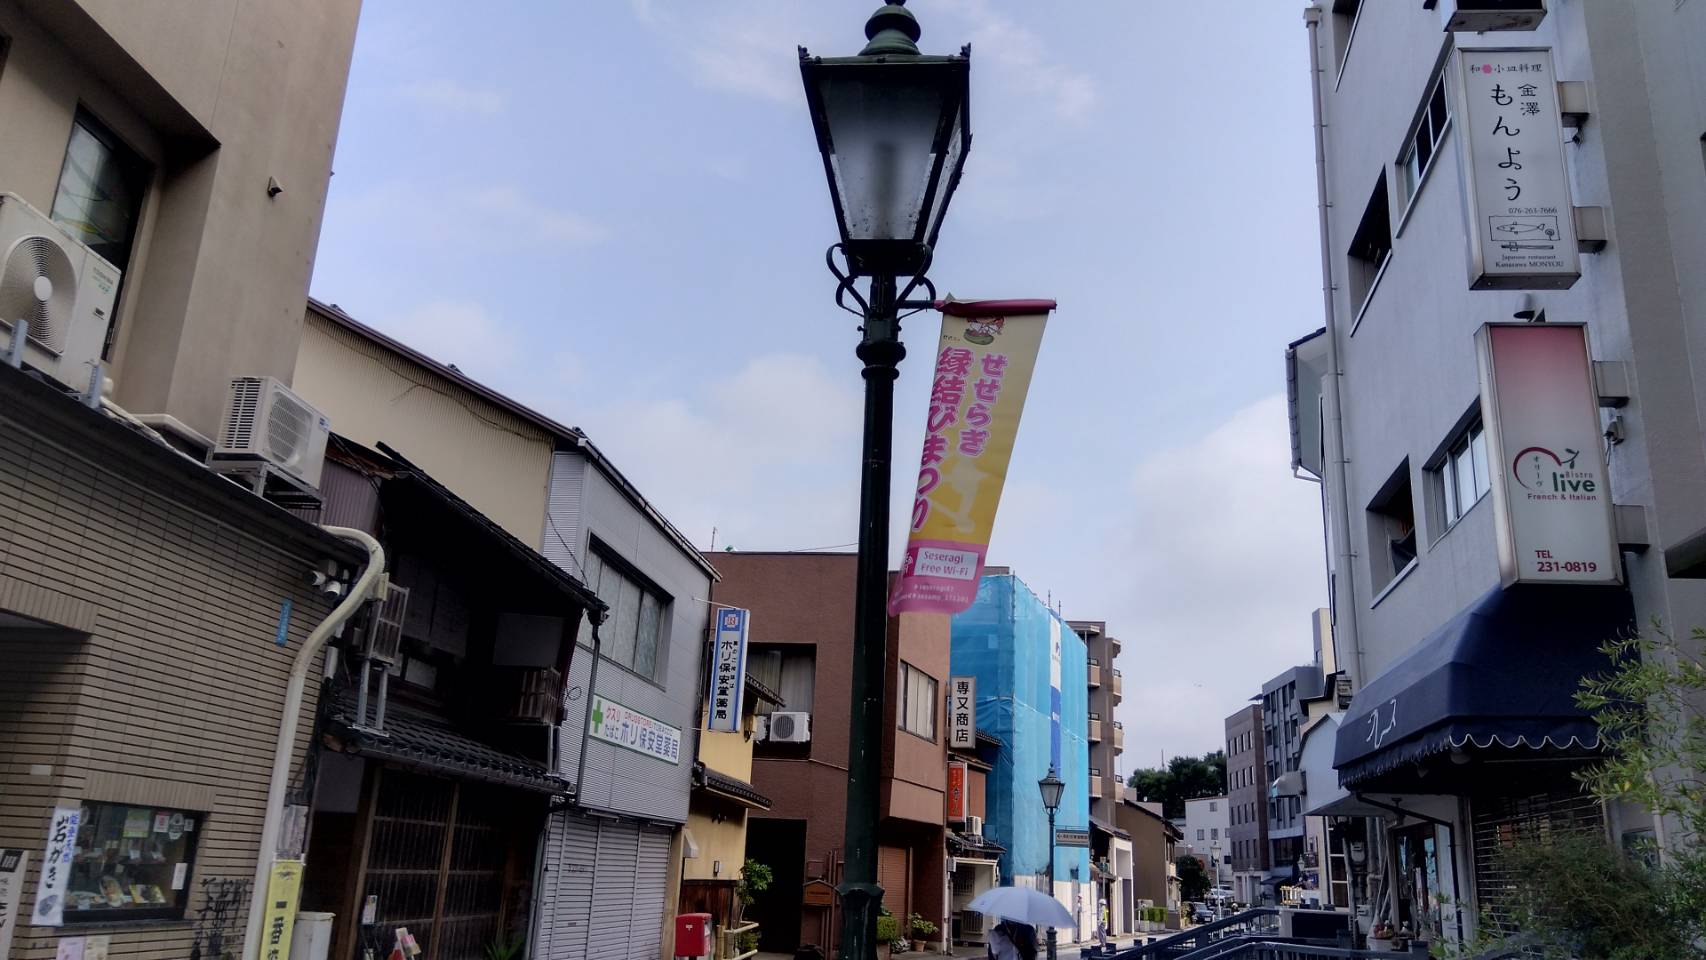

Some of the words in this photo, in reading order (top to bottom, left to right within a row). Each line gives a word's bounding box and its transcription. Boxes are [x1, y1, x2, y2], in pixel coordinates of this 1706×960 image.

[1517, 83, 1541, 116] 金澤
[1491, 83, 1523, 201] もんよう
[911, 345, 973, 531] 縁結びまつり
[1527, 493, 1557, 501] French
[923, 551, 964, 564] Seseragi
[1534, 550, 1553, 559] TEL
[920, 563, 942, 573] Free
[943, 565, 969, 577] Wi-Fi
[1537, 562, 1597, 573] 231-0819
[714, 640, 733, 720] ホリ保安堂薬局
[620, 720, 679, 761] ホリ保安堂薬局
